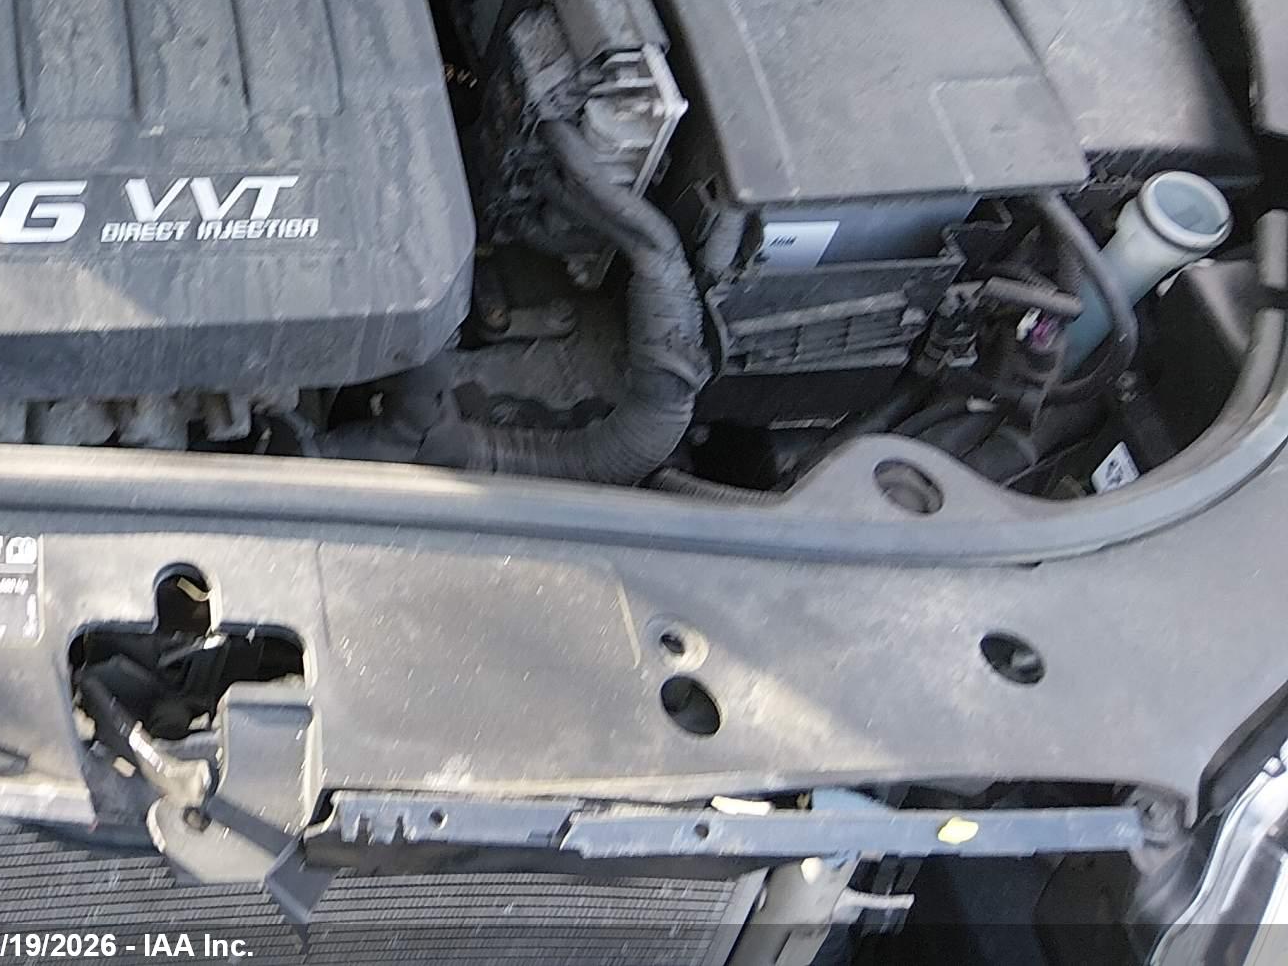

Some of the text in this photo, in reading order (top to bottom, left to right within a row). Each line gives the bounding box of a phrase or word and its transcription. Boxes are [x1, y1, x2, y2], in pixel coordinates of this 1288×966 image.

[125, 175, 300, 222] VVT
[100, 217, 320, 243] DIRECT INJECTION
